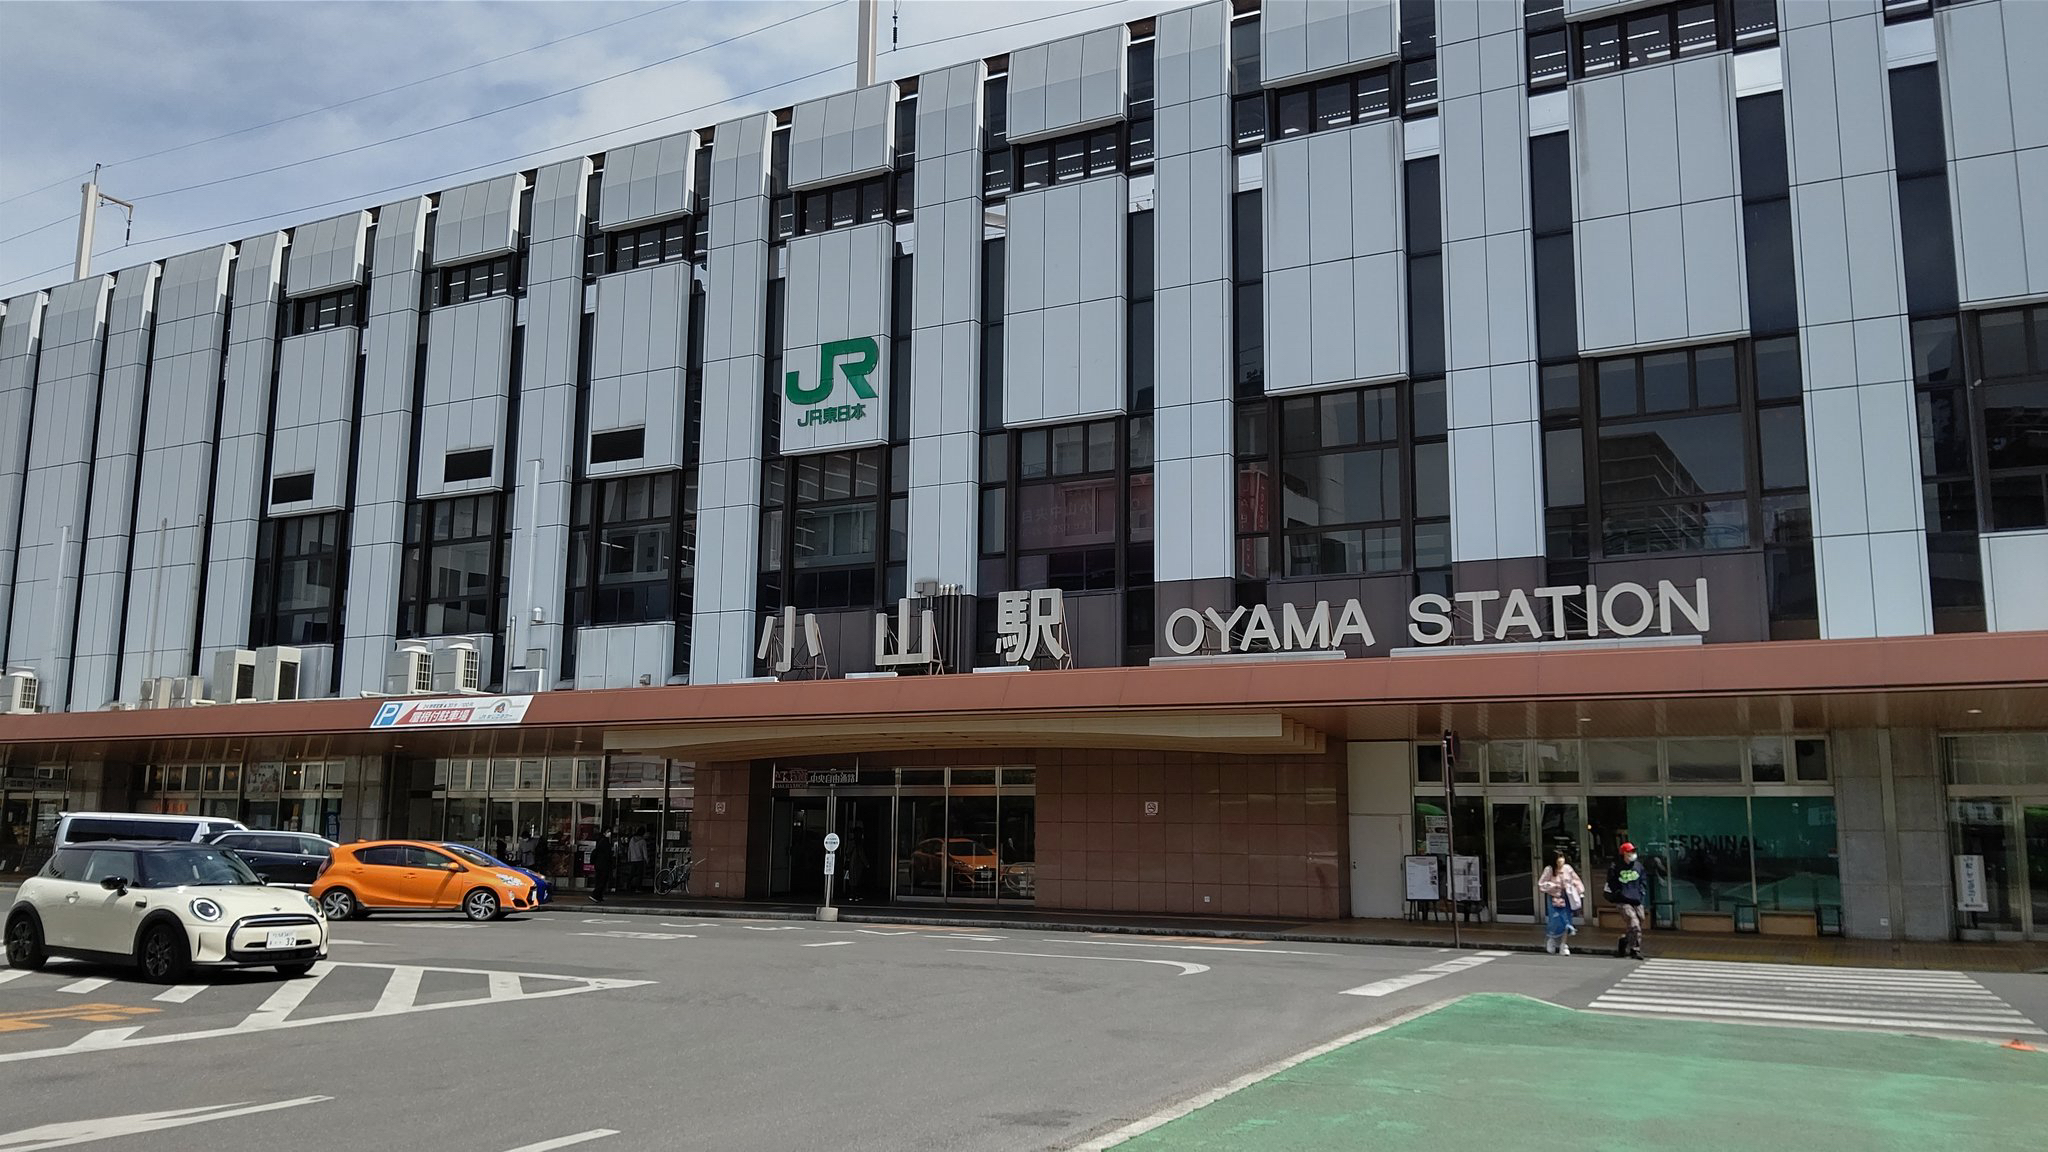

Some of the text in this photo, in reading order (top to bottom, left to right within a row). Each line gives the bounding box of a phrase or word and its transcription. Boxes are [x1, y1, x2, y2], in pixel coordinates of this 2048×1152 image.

[786, 337, 879, 405] JR
[797, 403, 866, 427] JR東日本
[757, 588, 1066, 672] 小山駅
[1165, 578, 1710, 655] OYAMA STATION
[1669, 834, 1763, 850] TERMINAL
